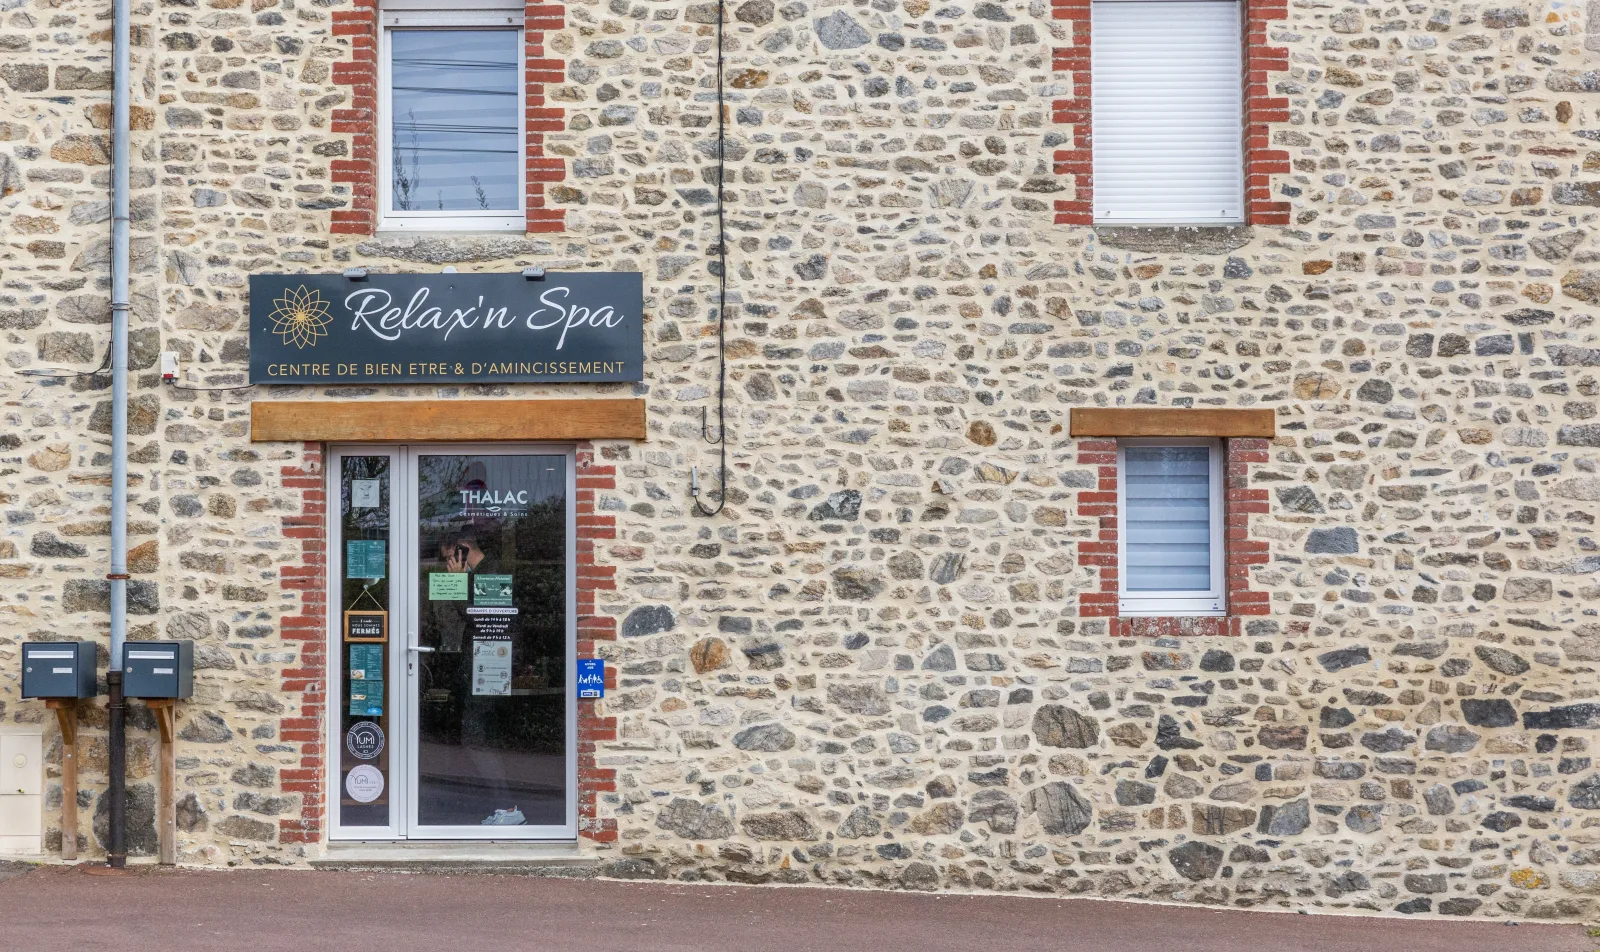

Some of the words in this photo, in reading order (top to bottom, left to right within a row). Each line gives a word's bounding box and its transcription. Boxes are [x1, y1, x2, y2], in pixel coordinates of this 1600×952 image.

[344, 287, 516, 341] Relax'n
[526, 286, 624, 350] Spa
[267, 363, 330, 376] CENTRE
[337, 363, 358, 376] DE
[365, 363, 402, 375] BIEN
[409, 362, 447, 375] ETRE
[454, 362, 465, 375] &
[471, 361, 624, 375] D'AMINCISSEMENT
[459, 490, 528, 504] THALAC
[350, 731, 375, 744] YUMI
[350, 774, 368, 784] YUMI
